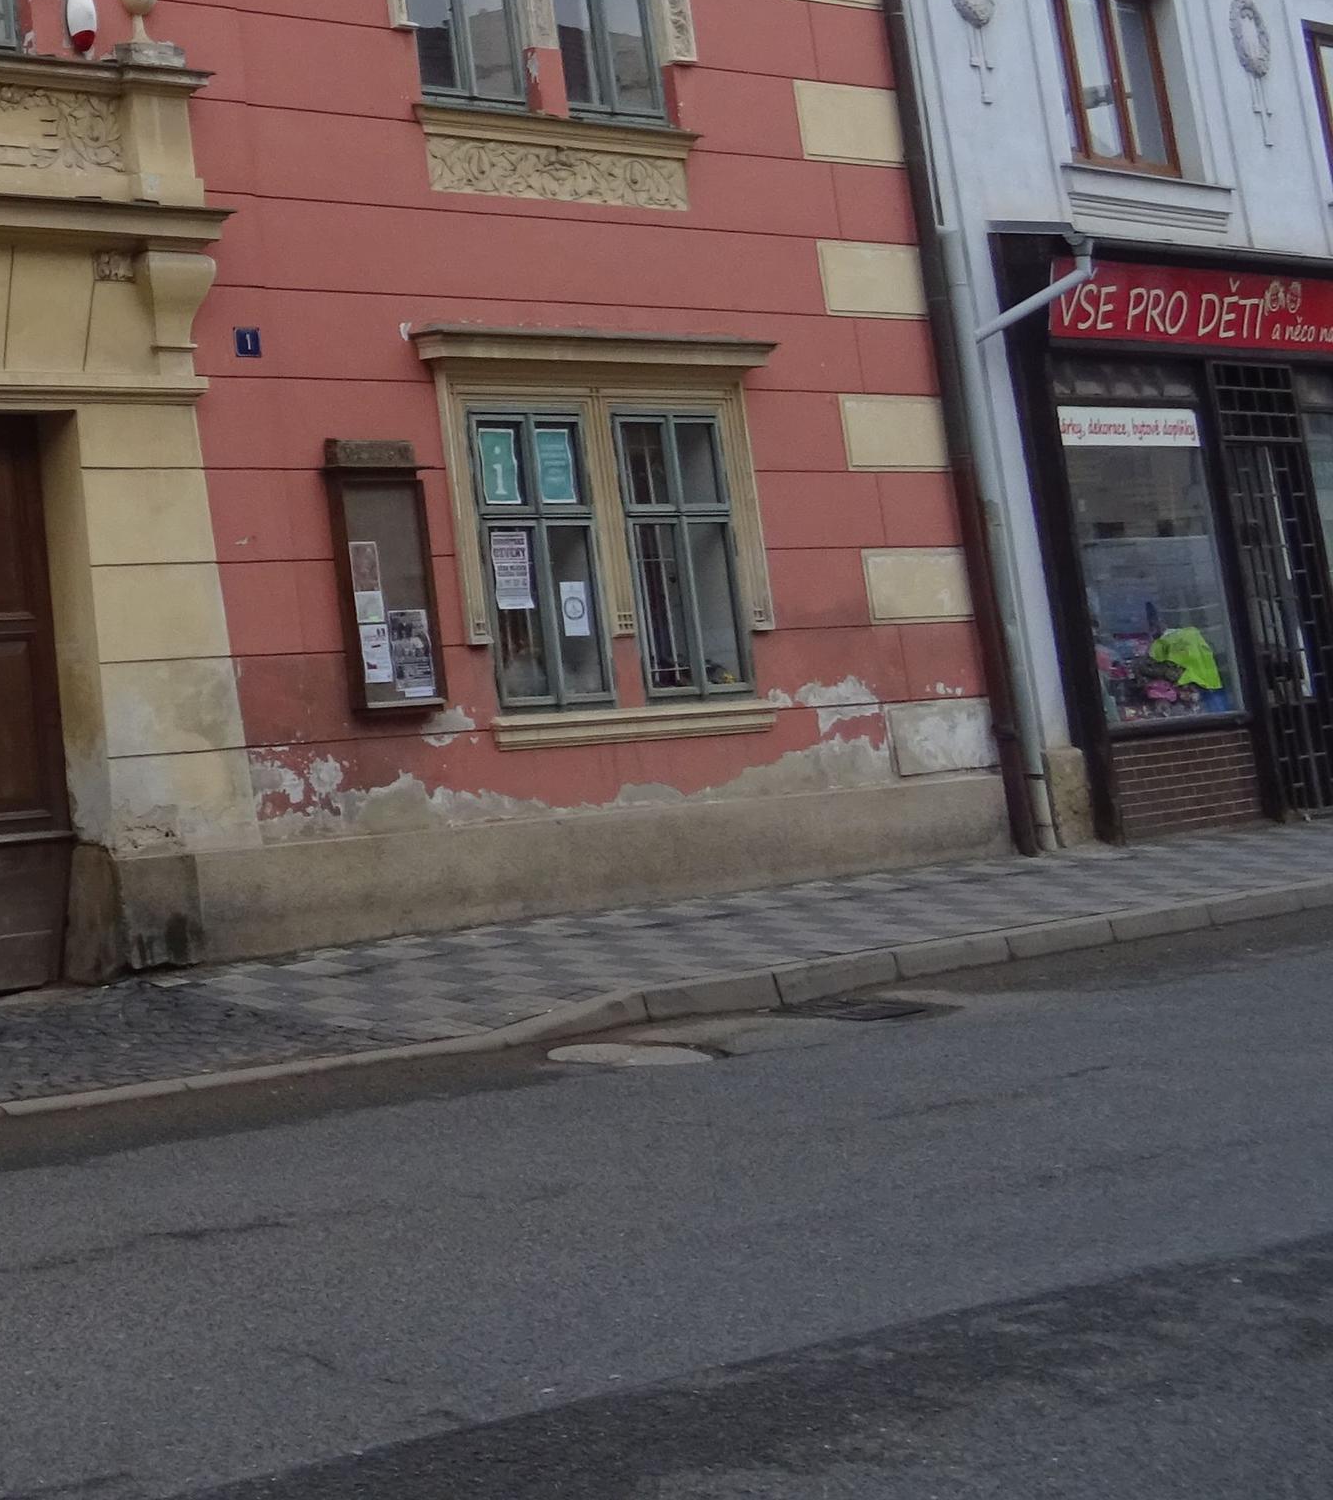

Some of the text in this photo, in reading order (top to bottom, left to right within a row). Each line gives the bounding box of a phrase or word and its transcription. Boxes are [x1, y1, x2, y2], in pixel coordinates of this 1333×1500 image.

[1126, 287, 1189, 335] PRO
[1197, 277, 1265, 340] DĚTI
[245, 334, 251, 350] 1
[1271, 323, 1281, 340] a
[1285, 316, 1315, 342] něco
